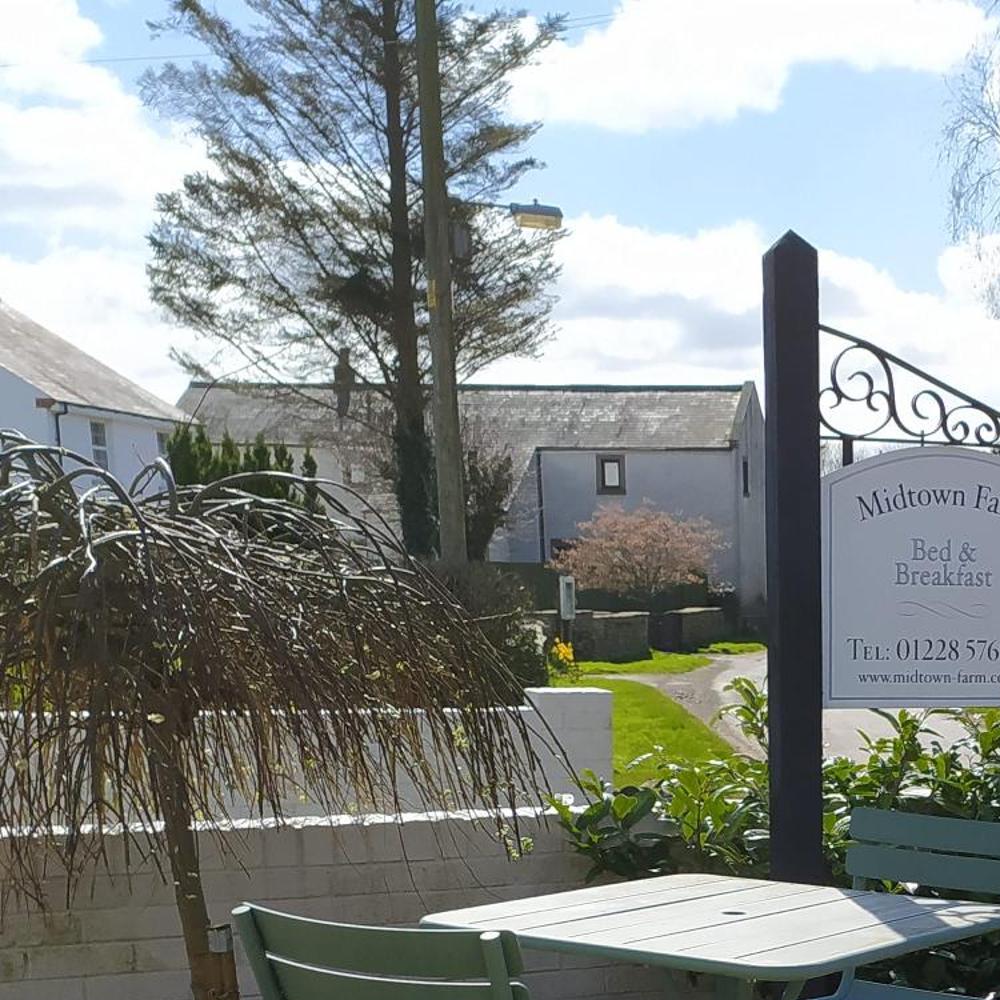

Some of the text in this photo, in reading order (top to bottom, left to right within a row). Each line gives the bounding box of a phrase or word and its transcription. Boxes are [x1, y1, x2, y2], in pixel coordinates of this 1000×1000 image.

[856, 483, 966, 522] Midtown
[911, 538, 976, 562] Bed &
[894, 562, 993, 587] Breakfast
[896, 638, 960, 661] 01228
